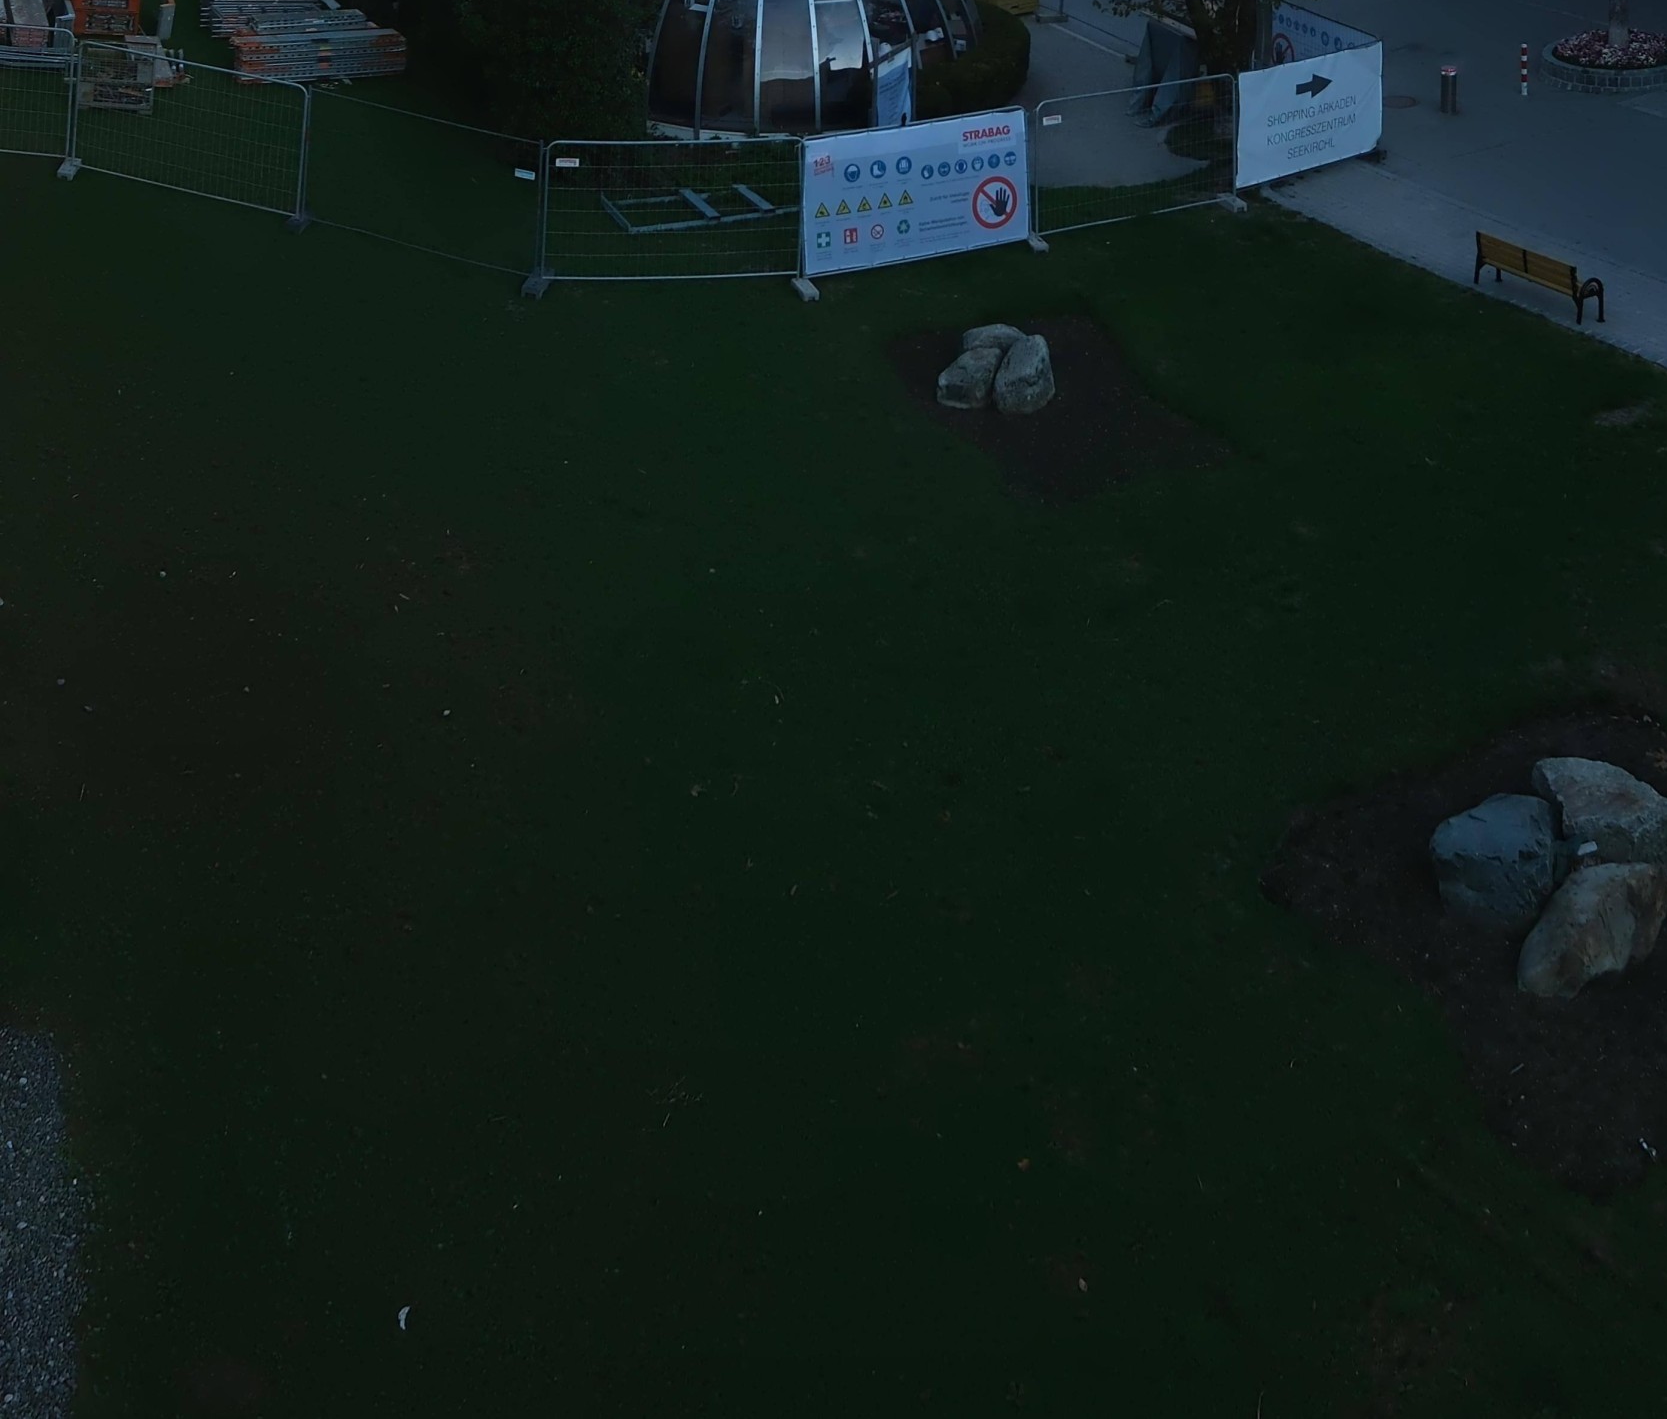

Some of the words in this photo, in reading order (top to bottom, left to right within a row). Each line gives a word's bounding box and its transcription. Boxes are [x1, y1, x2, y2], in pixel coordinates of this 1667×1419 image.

[1267, 105, 1316, 127] SHOPPING
[1317, 94, 1357, 115] ARKADEN
[962, 125, 1011, 142] STRABAG
[1266, 113, 1357, 147] KONGRESSZENTRUM
[1287, 137, 1336, 160] SEEKIRCHL
